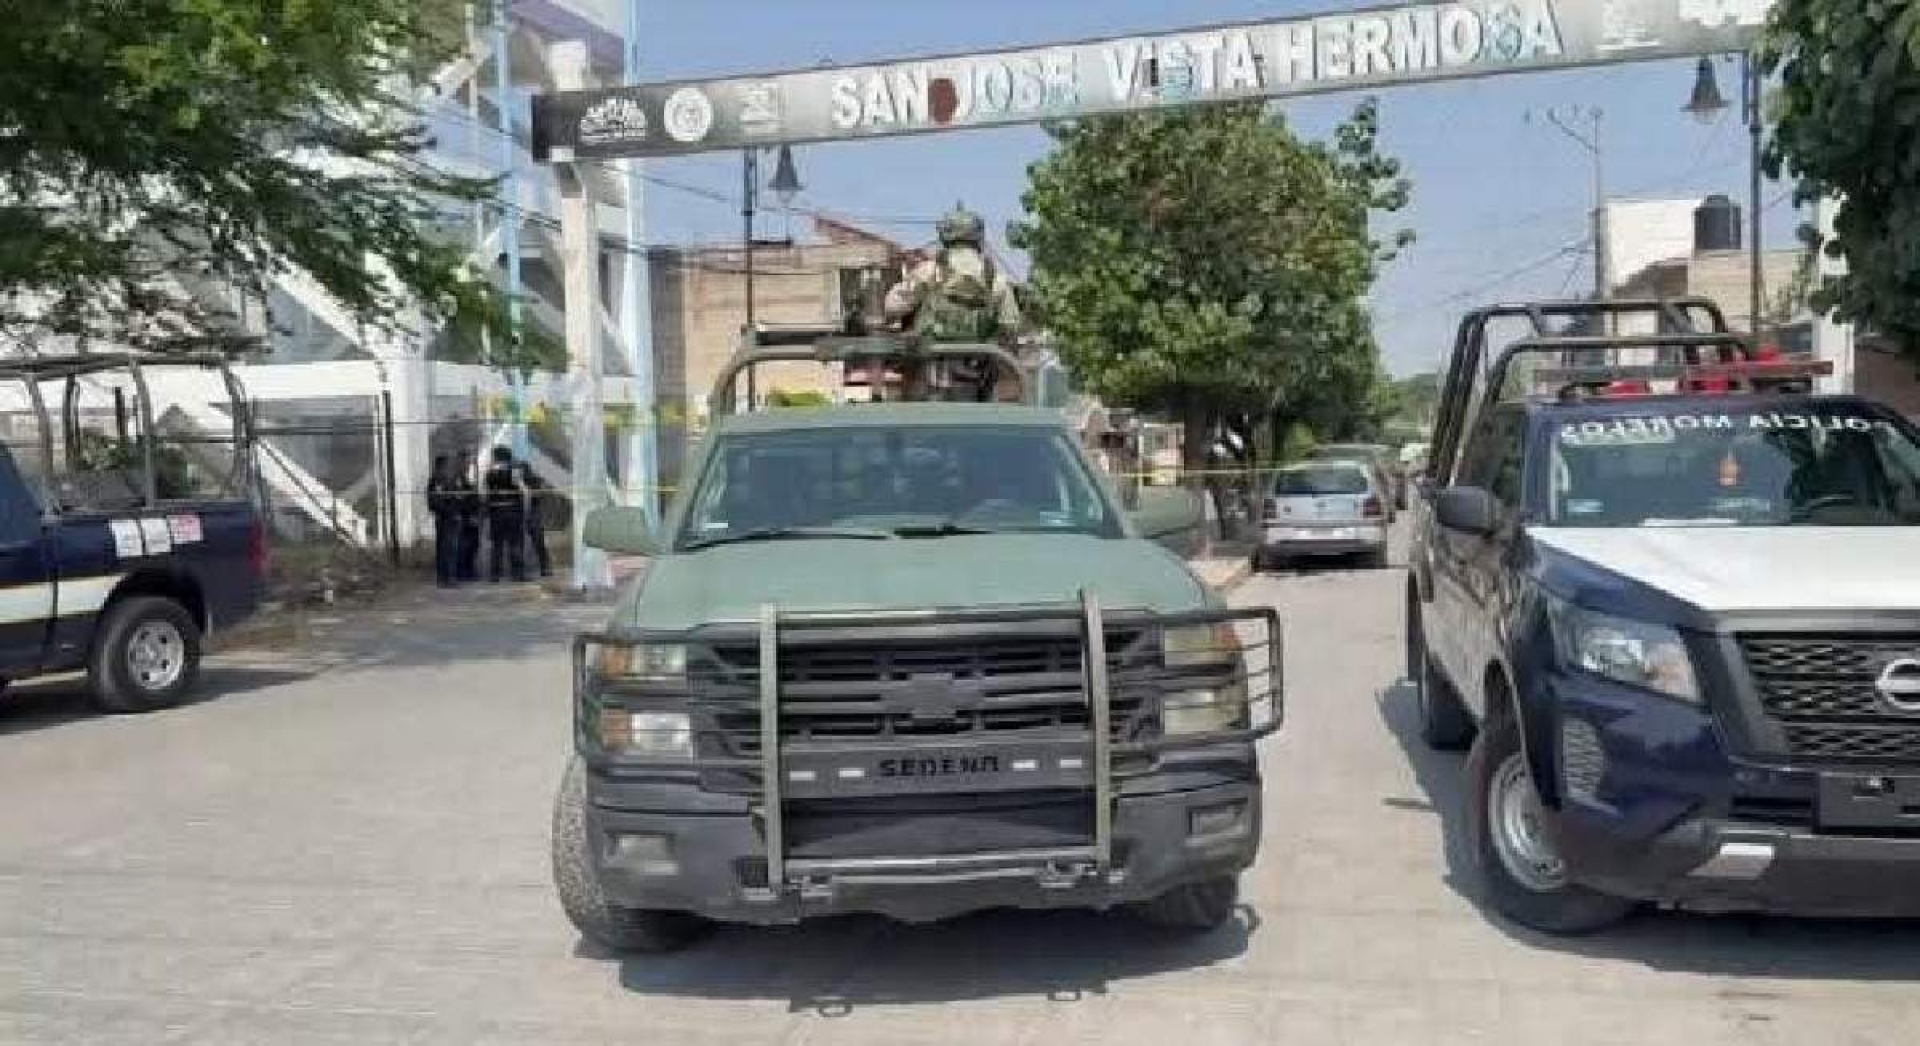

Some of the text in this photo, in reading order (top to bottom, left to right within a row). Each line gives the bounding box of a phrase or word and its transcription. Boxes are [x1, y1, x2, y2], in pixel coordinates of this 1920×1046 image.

[831, 63, 930, 127] SAN
[1103, 29, 1266, 103] VISTA
[1280, 0, 1564, 84] HERMOSA
[879, 755, 999, 777] SEDENA
